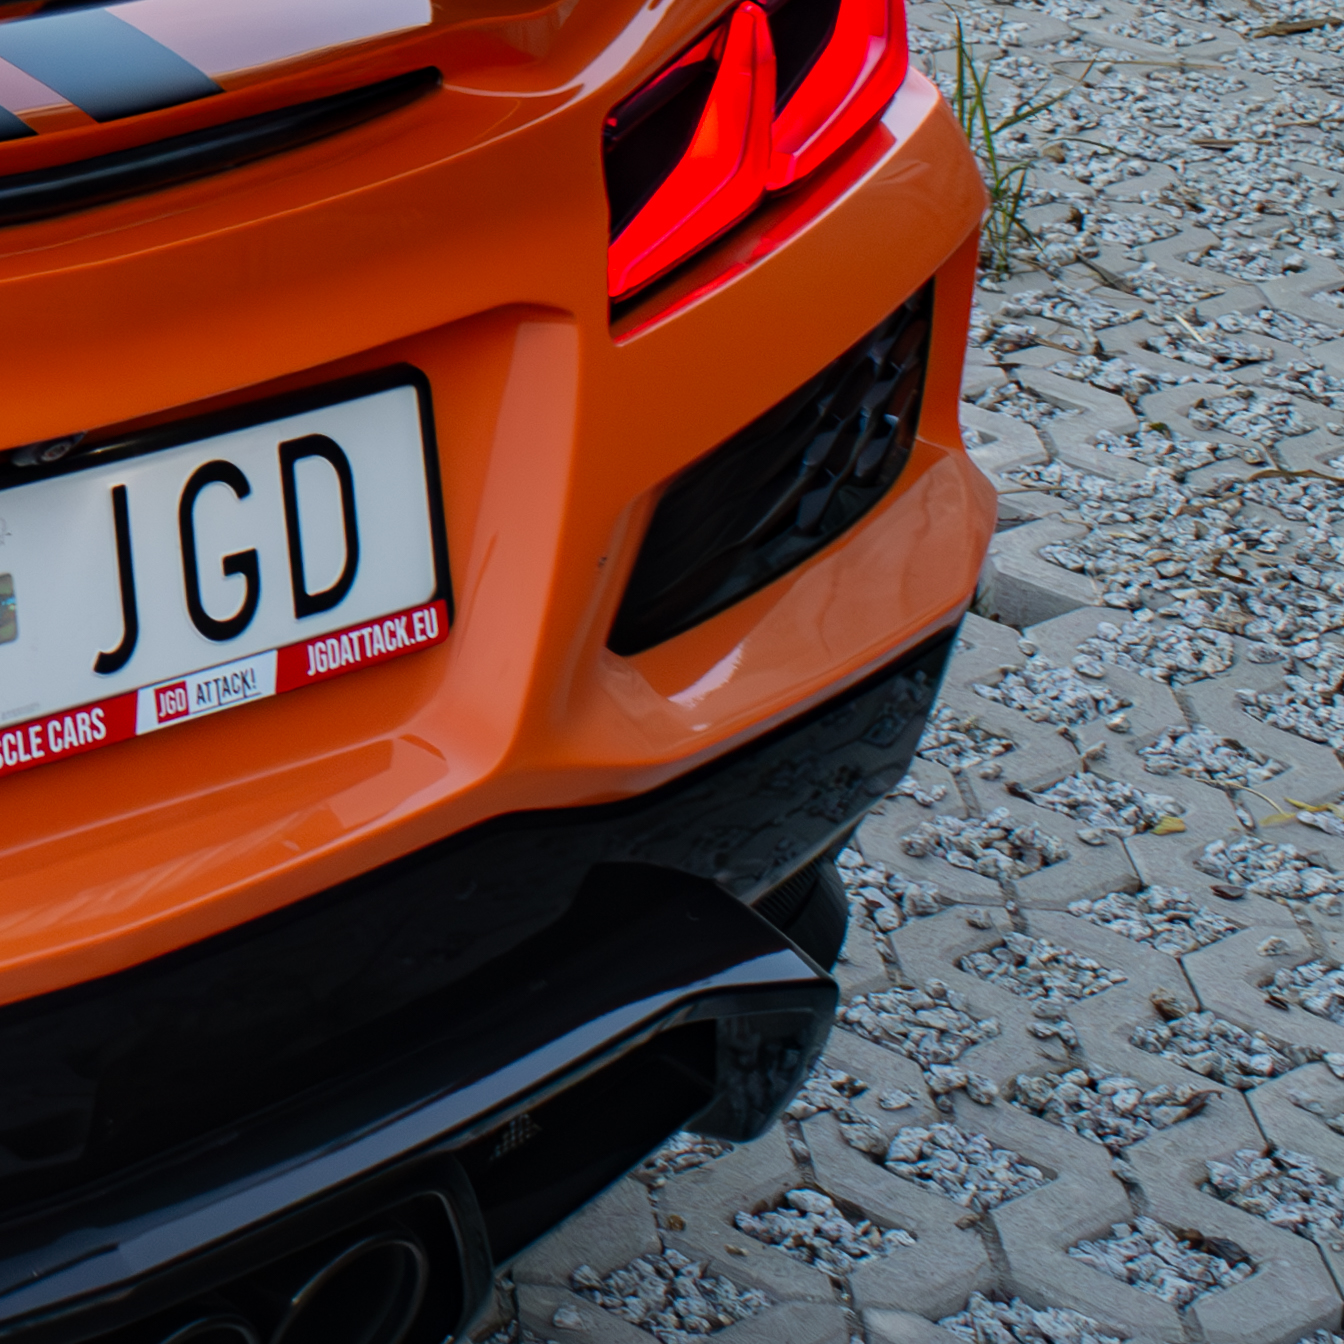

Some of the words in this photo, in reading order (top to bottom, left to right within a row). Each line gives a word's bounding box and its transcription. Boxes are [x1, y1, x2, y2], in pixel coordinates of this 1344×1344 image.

[92, 432, 360, 675] JGD
[307, 607, 439, 676] JGDATTACK.EU
[158, 687, 187, 718] JGD
[196, 667, 257, 706] ATTACK!
[47, 707, 107, 753] CARS
